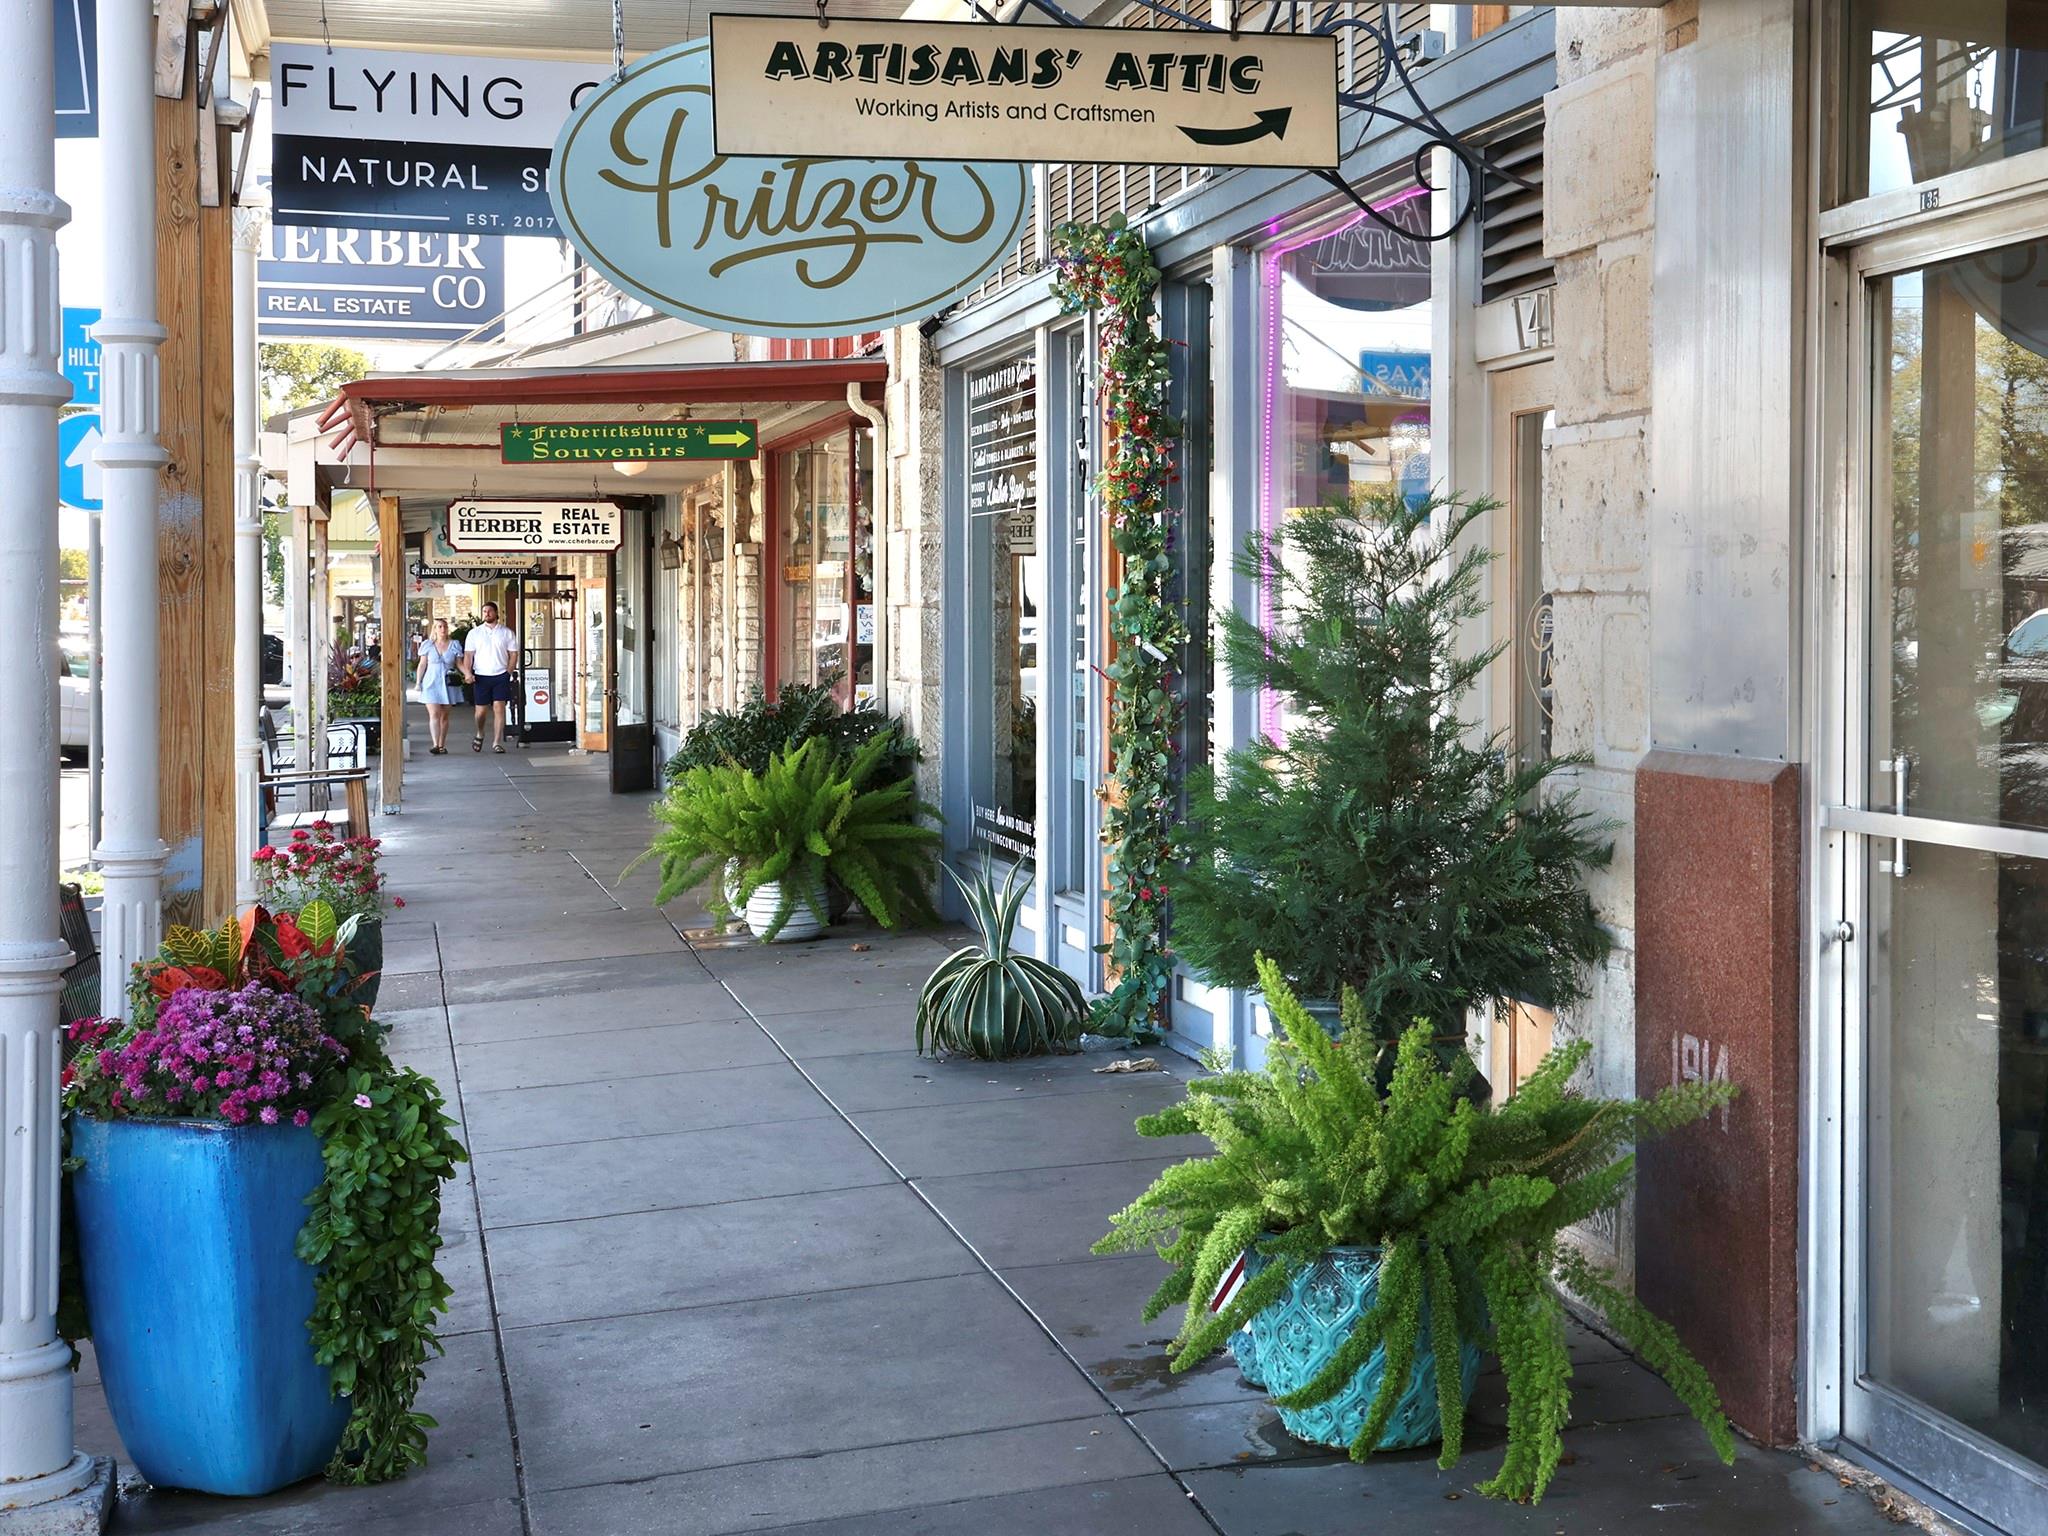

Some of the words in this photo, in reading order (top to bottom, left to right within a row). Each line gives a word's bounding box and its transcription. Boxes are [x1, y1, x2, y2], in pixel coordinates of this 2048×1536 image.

[764, 41, 1082, 90] ARTISANS'
[1104, 51, 1265, 95] ATTIC
[281, 63, 523, 119] FLYING
[856, 97, 938, 123] Working
[944, 100, 1000, 121] Artists
[1007, 103, 1048, 121] and
[1053, 104, 1156, 124] Craftsmen
[302, 155, 488, 190] NATURAL
[598, 84, 995, 290] Pritzer
[1921, 190, 1939, 210] 135
[466, 213, 505, 227] EST.
[514, 216, 555, 229] 2017
[432, 274, 486, 309] CO
[268, 295, 326, 313] REAL
[334, 298, 411, 315] ESTATE
[528, 426, 689, 441] Fredericksburg
[532, 442, 686, 459] Souvenirs
[458, 507, 477, 518] CC
[561, 508, 600, 520] REAL
[458, 519, 542, 533] HERBER
[553, 523, 610, 535] ESTATE
[524, 534, 542, 544] CO
